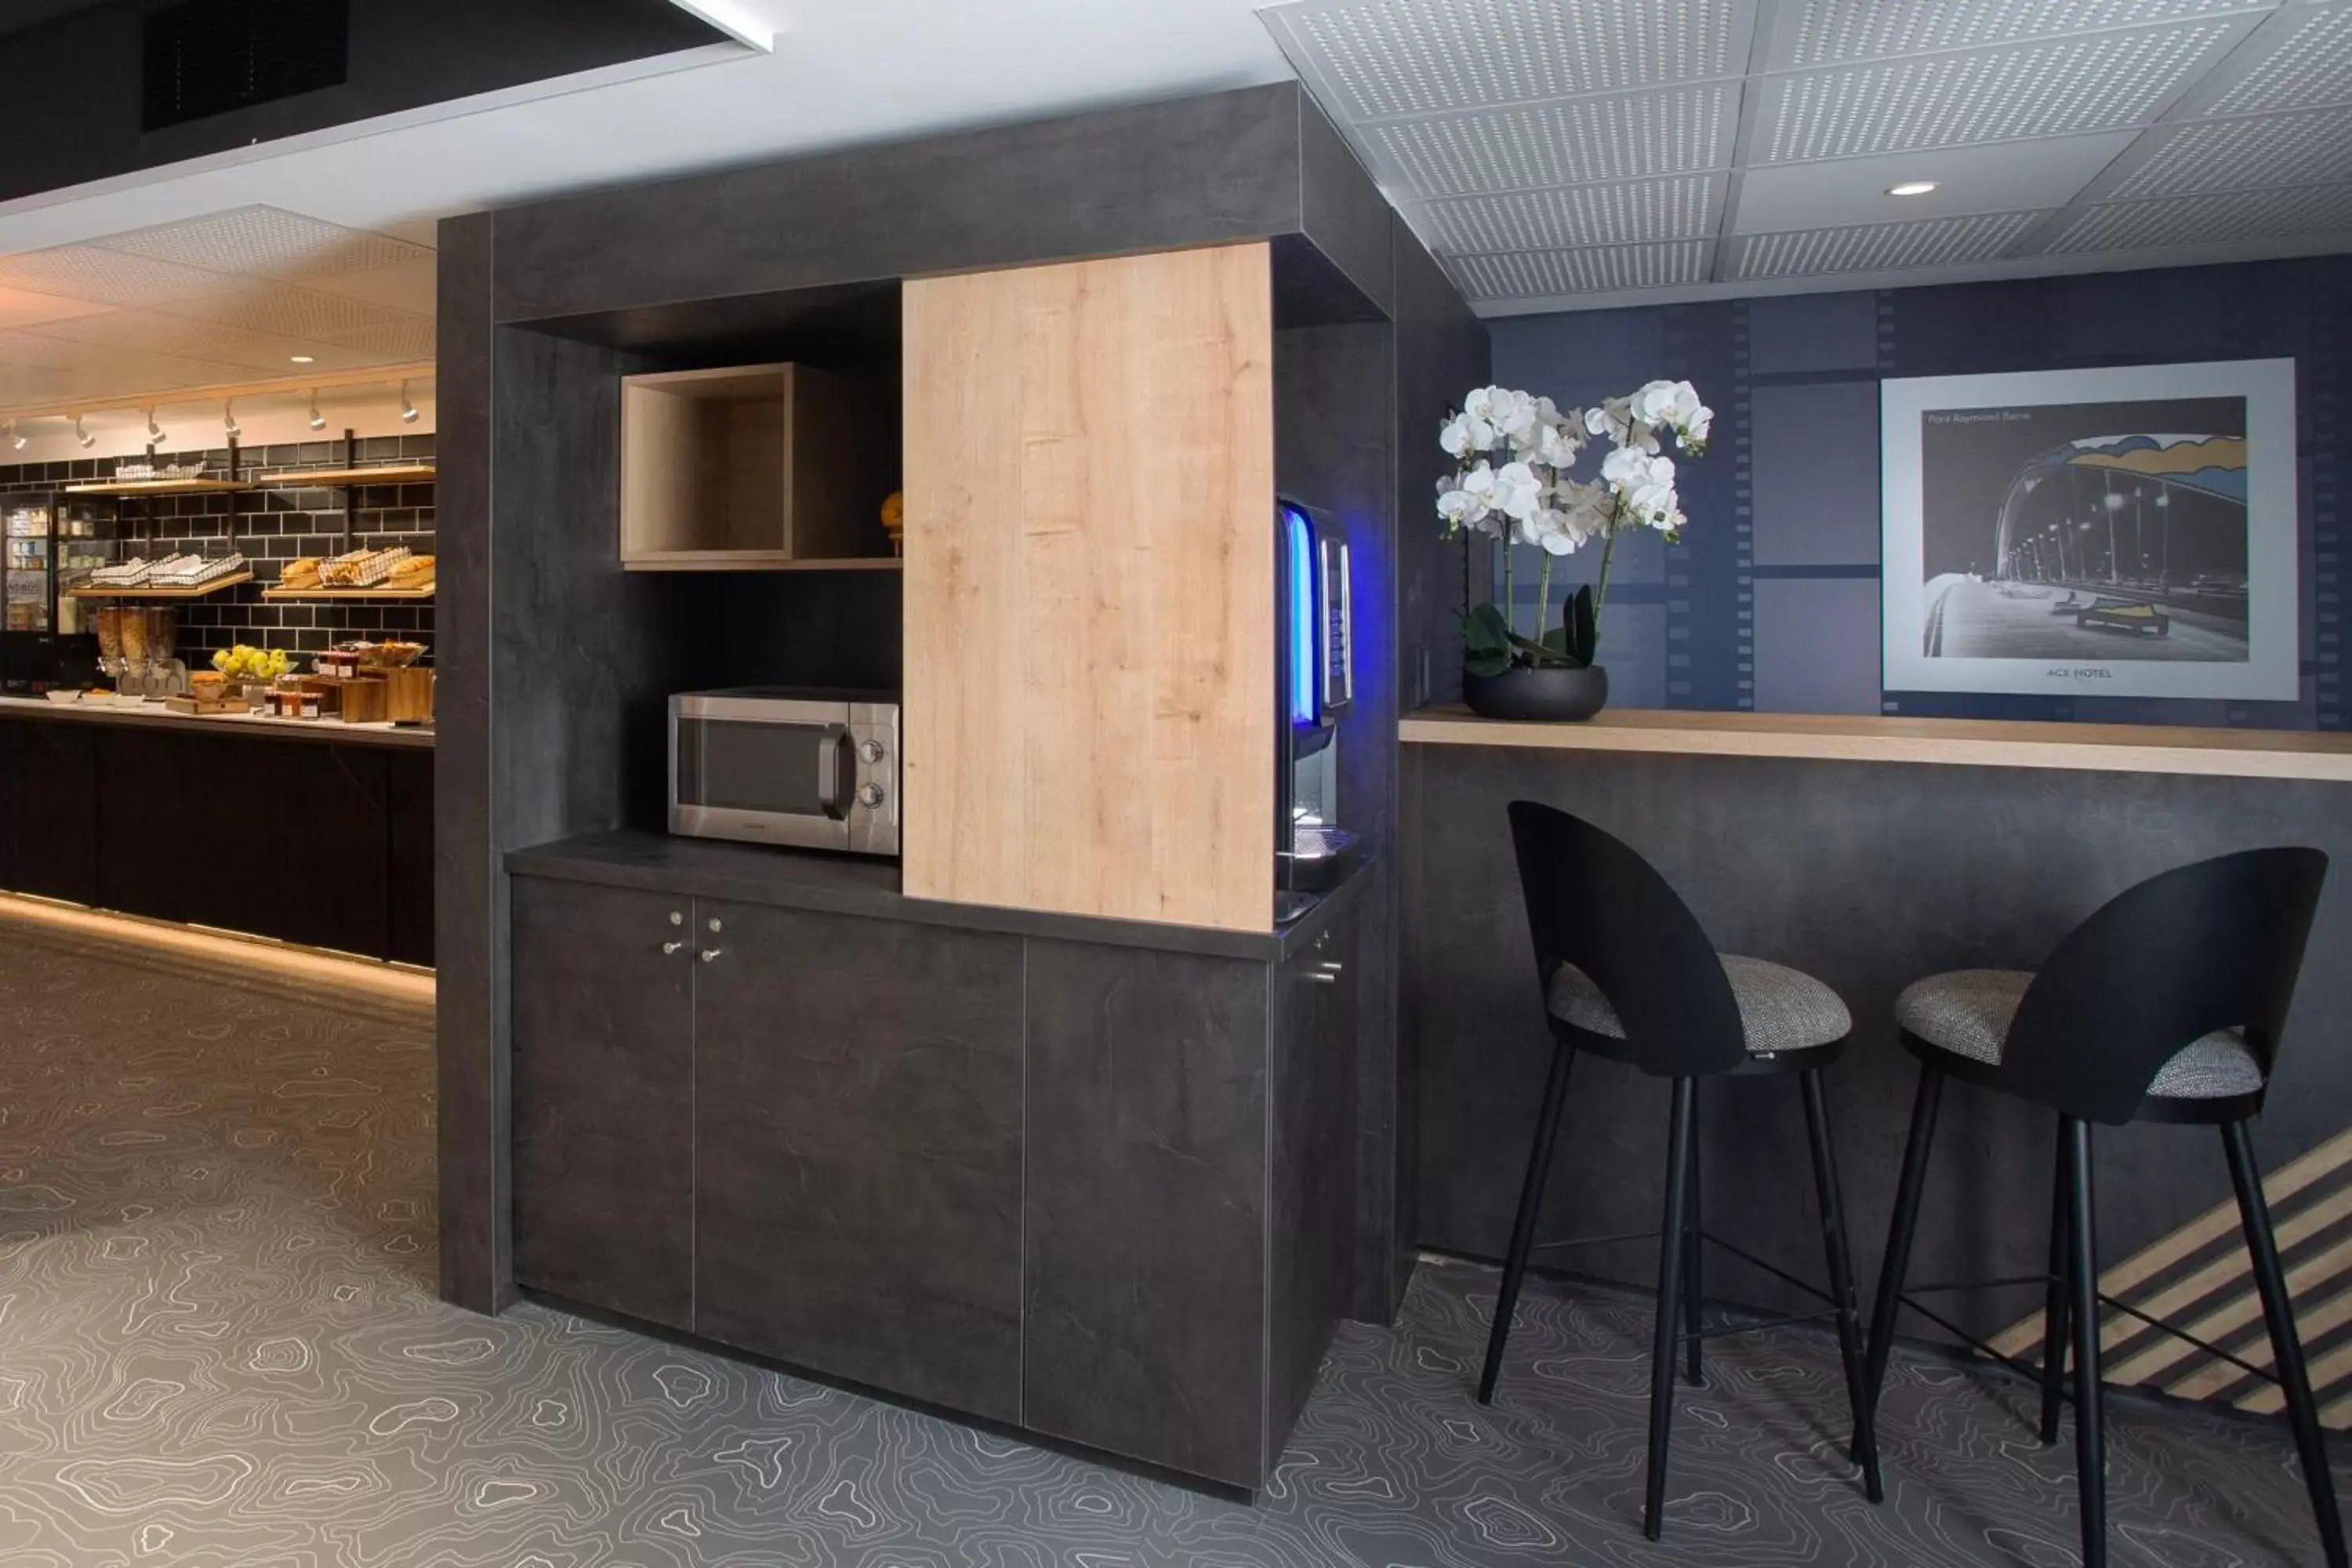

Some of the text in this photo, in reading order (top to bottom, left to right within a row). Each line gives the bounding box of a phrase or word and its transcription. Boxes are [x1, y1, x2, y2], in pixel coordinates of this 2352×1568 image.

[1952, 412, 2000, 425] Raymond
[2046, 668, 2114, 678] ACE HOTEL
